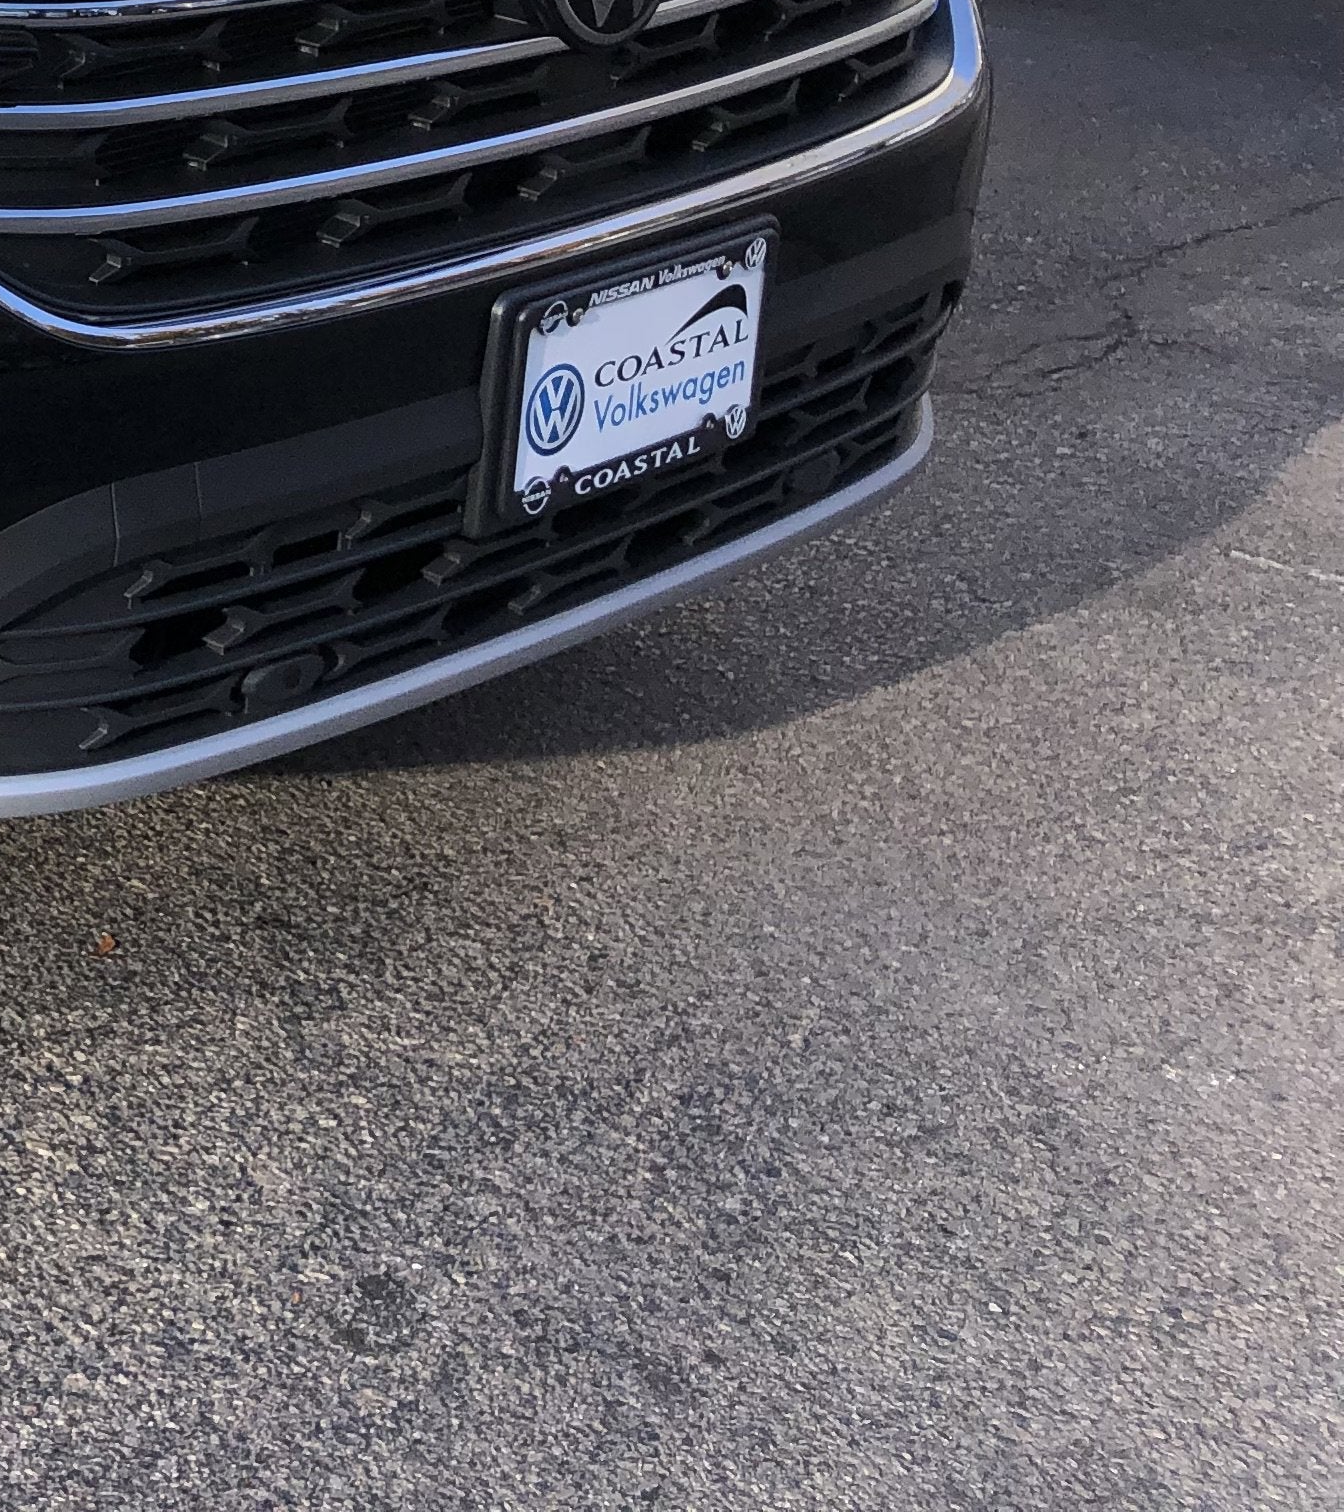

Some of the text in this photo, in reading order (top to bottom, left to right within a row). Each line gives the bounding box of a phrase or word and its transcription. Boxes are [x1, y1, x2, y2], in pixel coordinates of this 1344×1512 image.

[588, 254, 726, 307] NISSAN Volkswagen
[593, 318, 749, 388] COASTAL
[593, 359, 746, 434] Volkswagen
[574, 436, 701, 496] COASTAL
